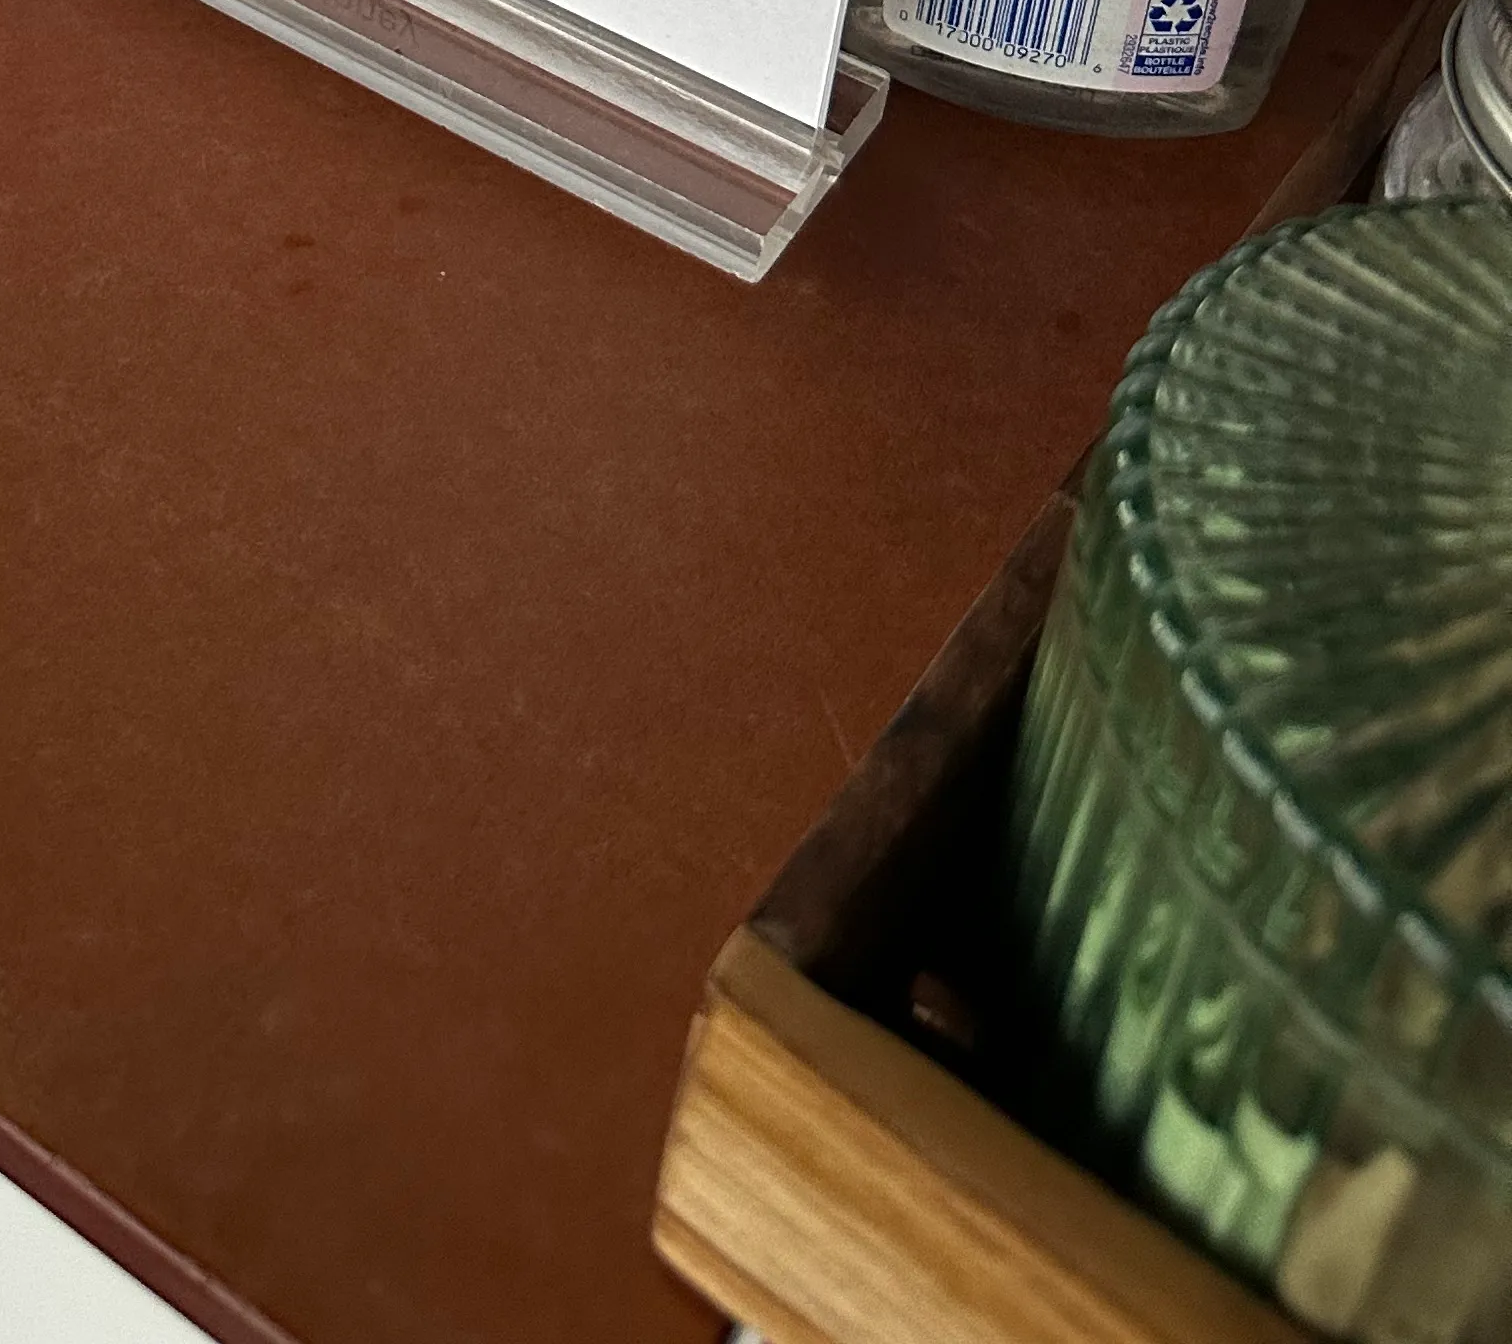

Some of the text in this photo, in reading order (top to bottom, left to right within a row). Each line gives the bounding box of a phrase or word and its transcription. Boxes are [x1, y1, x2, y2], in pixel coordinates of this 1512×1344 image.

[1149, 36, 1190, 45] PLASTIC
[1139, 45, 1193, 54] PLASTIQUE
[1002, 40, 1067, 71] 09270
[1092, 62, 1102, 74] 6
[1144, 56, 1186, 66] BOTTLE
[1133, 65, 1191, 75] BOUTEILLE
